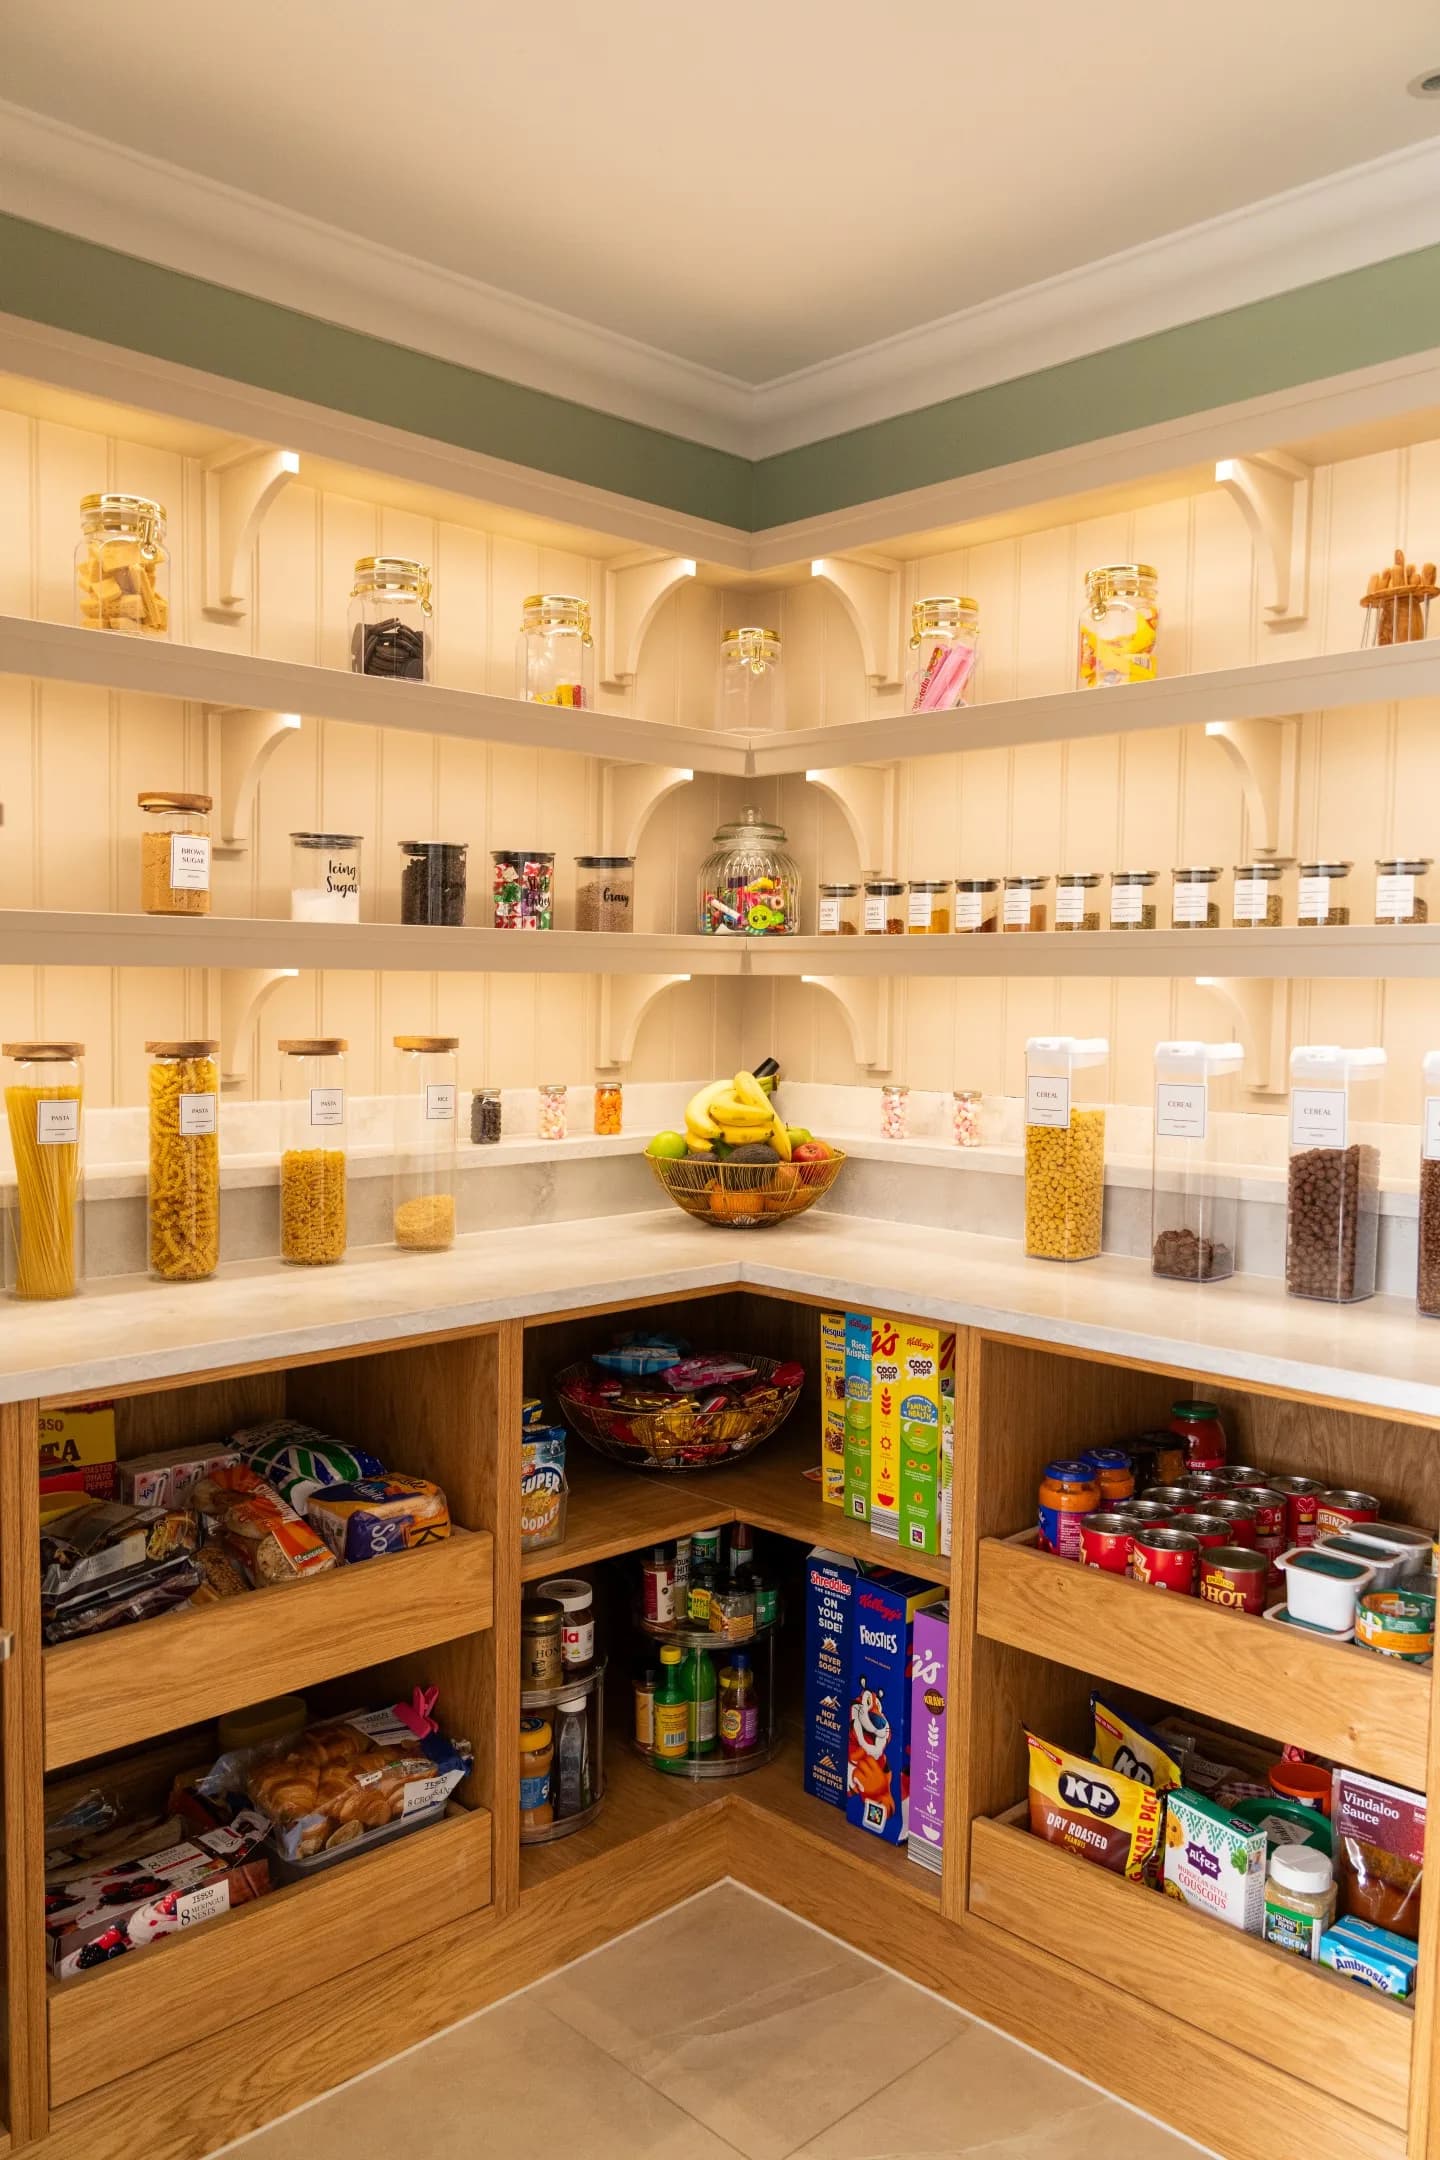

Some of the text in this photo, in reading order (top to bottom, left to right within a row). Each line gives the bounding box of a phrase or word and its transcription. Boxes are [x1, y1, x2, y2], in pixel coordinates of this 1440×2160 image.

[329, 859, 356, 881] Icing
[326, 875, 358, 899] Sugar
[1036, 1091, 1058, 1099] CEREAL
[1167, 1100, 1193, 1109] CEREAL
[1303, 1107, 1332, 1116] CEREAL
[850, 1339, 866, 1352] Rice
[906, 1336, 934, 1351] Kellogg's
[880, 1372, 896, 1380] pops
[913, 1367, 931, 1376] pops
[37, 1418, 64, 1432] aso
[1319, 1513, 1346, 1530] HEINZ
[810, 1571, 852, 1596] Shreddies
[824, 1596, 838, 1610] ON
[1206, 1585, 1246, 1608] HOT
[817, 1605, 849, 1623] YOUR
[818, 1617, 848, 1634] SIDE!
[818, 1660, 841, 1676] SOGGY
[819, 1652, 841, 1668] NEVER
[821, 1708, 836, 1721] NOT
[1113, 1750, 1150, 1787] KP
[812, 1771, 843, 1791] OVER STYLE
[1064, 1774, 1115, 1810] KP
[407, 1799, 413, 1807] 8
[1343, 1790, 1400, 1820] Vindaloo
[1342, 1803, 1380, 1825] Sauce
[1046, 1812, 1108, 1851] DRY ROASTED
[1064, 1834, 1087, 1849] PEANUTS
[191, 1889, 214, 1904] TESCO
[1178, 1872, 1227, 1909] COUSCOUS
[181, 1908, 216, 1927] 8 NESTS
[1267, 1931, 1308, 1952] CHICKEN
[1335, 1958, 1390, 1991] Ambrosia
